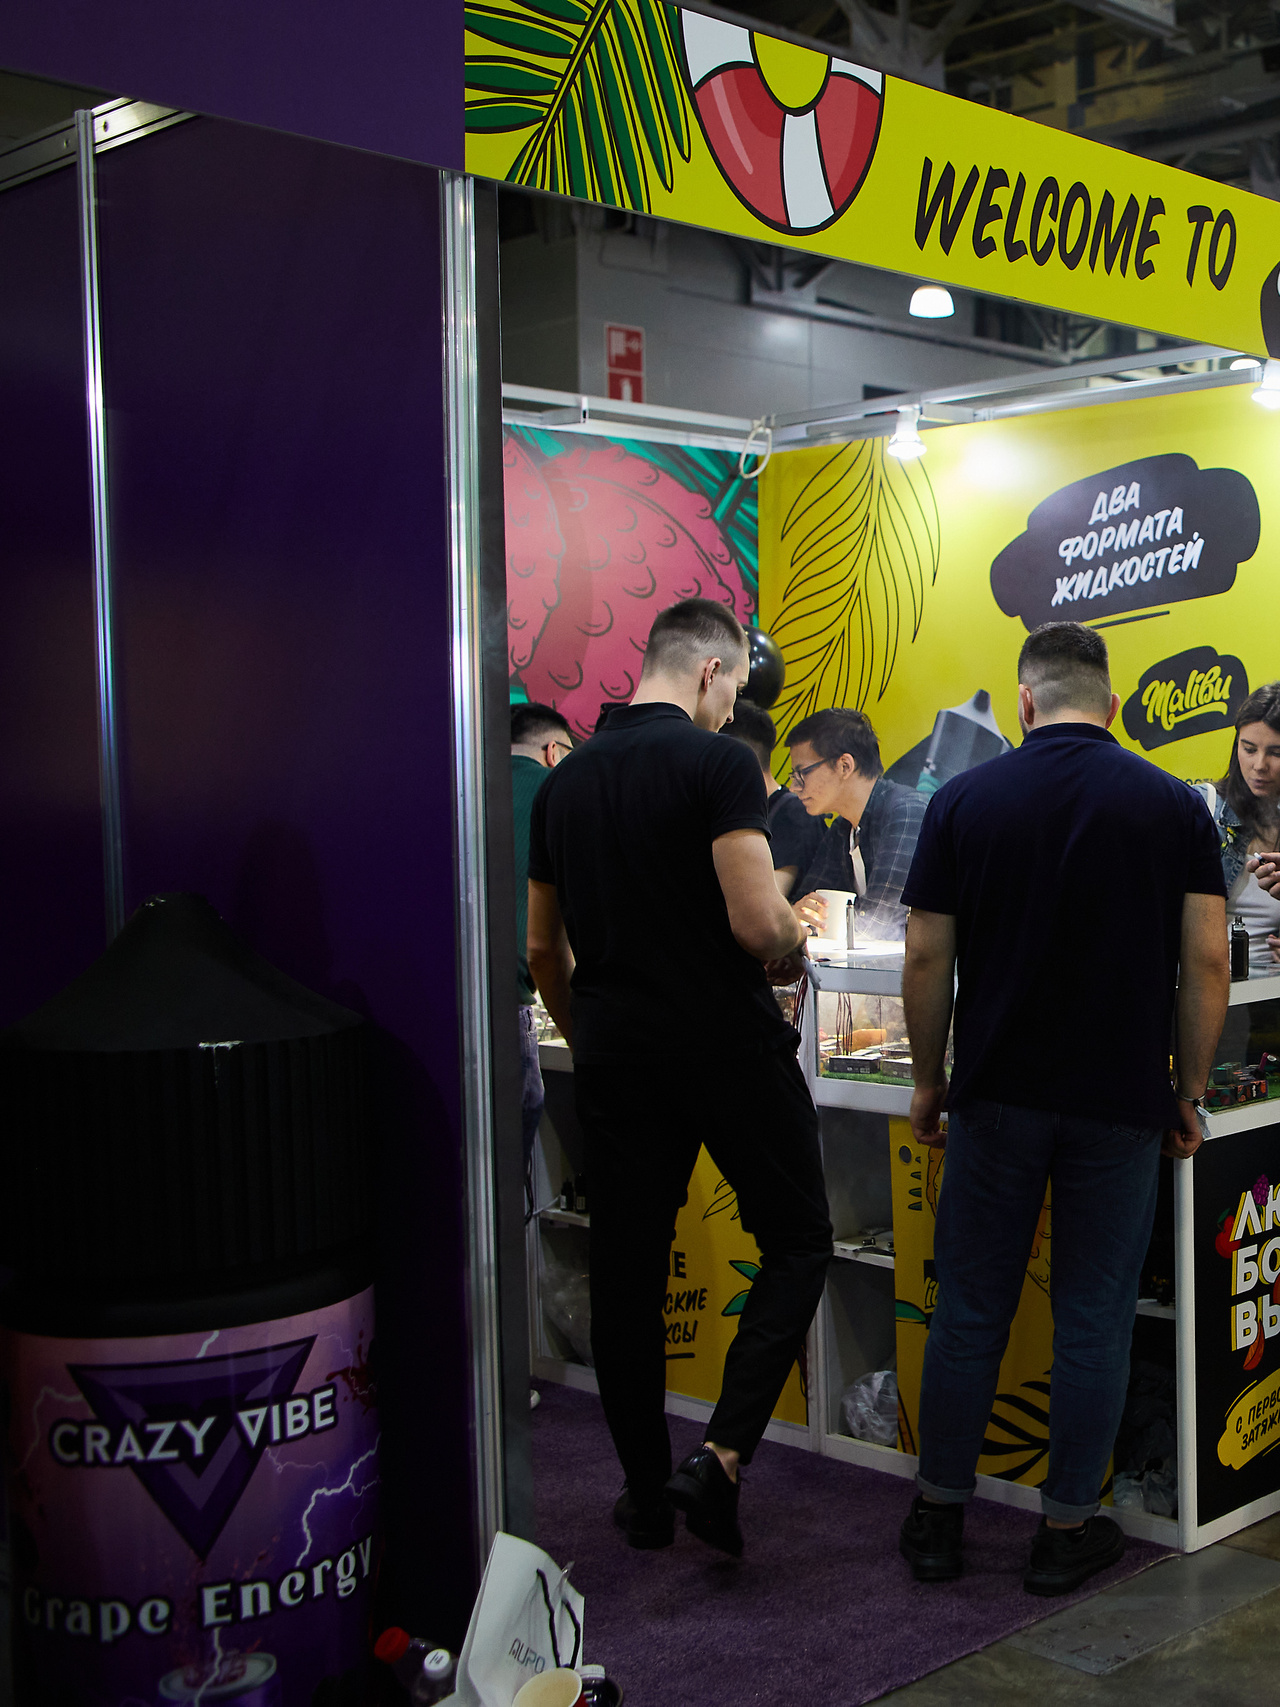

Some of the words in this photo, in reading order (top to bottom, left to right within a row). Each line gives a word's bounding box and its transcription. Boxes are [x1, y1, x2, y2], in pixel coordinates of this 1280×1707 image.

[914, 156, 1166, 281] WELCOME
[1186, 205, 1237, 291] TO
[1058, 506, 1183, 566] ФОРМАТА
[1088, 481, 1140, 525] ДВА
[1051, 532, 1205, 607] ЖИДКОСТЕЙ
[661, 1288, 708, 1314] СКИЕ
[52, 1416, 218, 1462] CRAZY
[236, 1387, 338, 1449] VIBE
[23, 1586, 171, 1643] Grape
[202, 1534, 374, 1628] Energy
